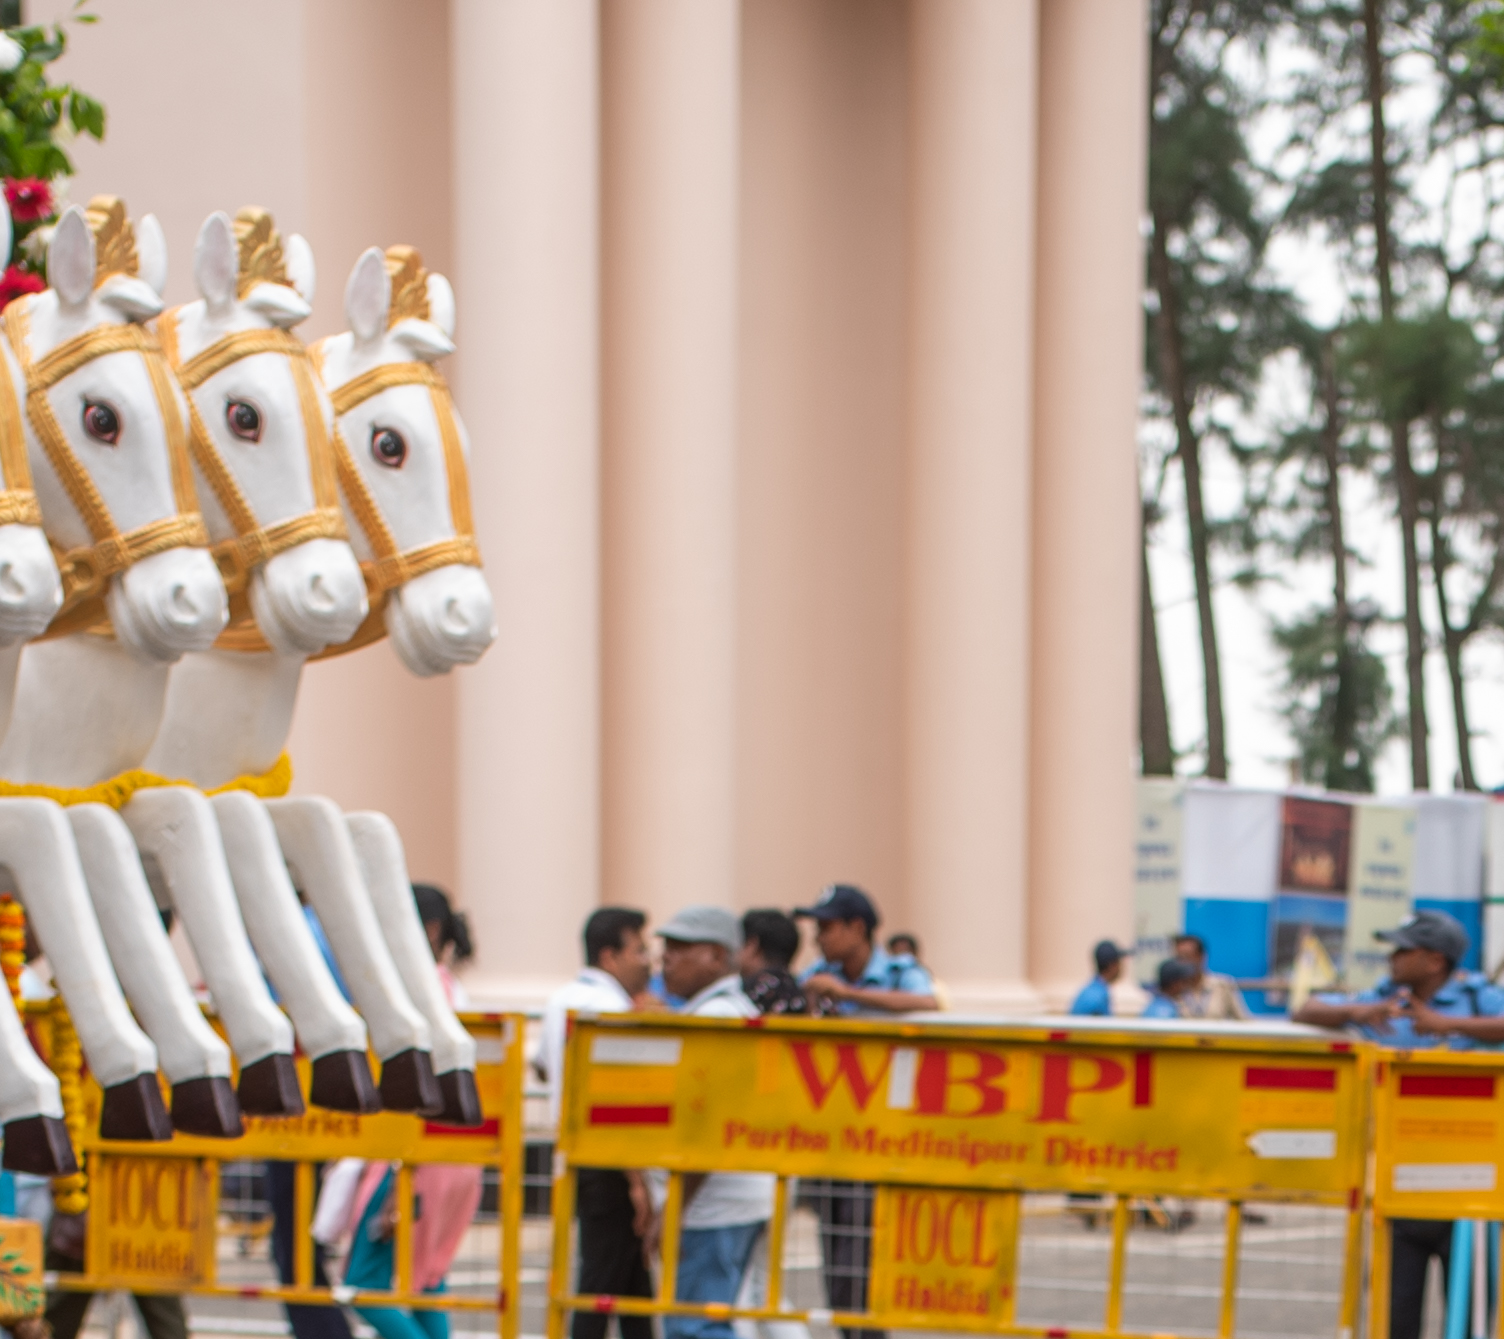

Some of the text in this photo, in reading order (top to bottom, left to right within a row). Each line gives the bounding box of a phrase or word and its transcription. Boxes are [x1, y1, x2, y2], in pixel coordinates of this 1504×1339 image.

[787, 1040, 1128, 1125] WBP
[722, 1120, 1180, 1172] Purba Medinipur District
[892, 1192, 999, 1268] IOCL
[894, 1276, 991, 1317] Haldia
